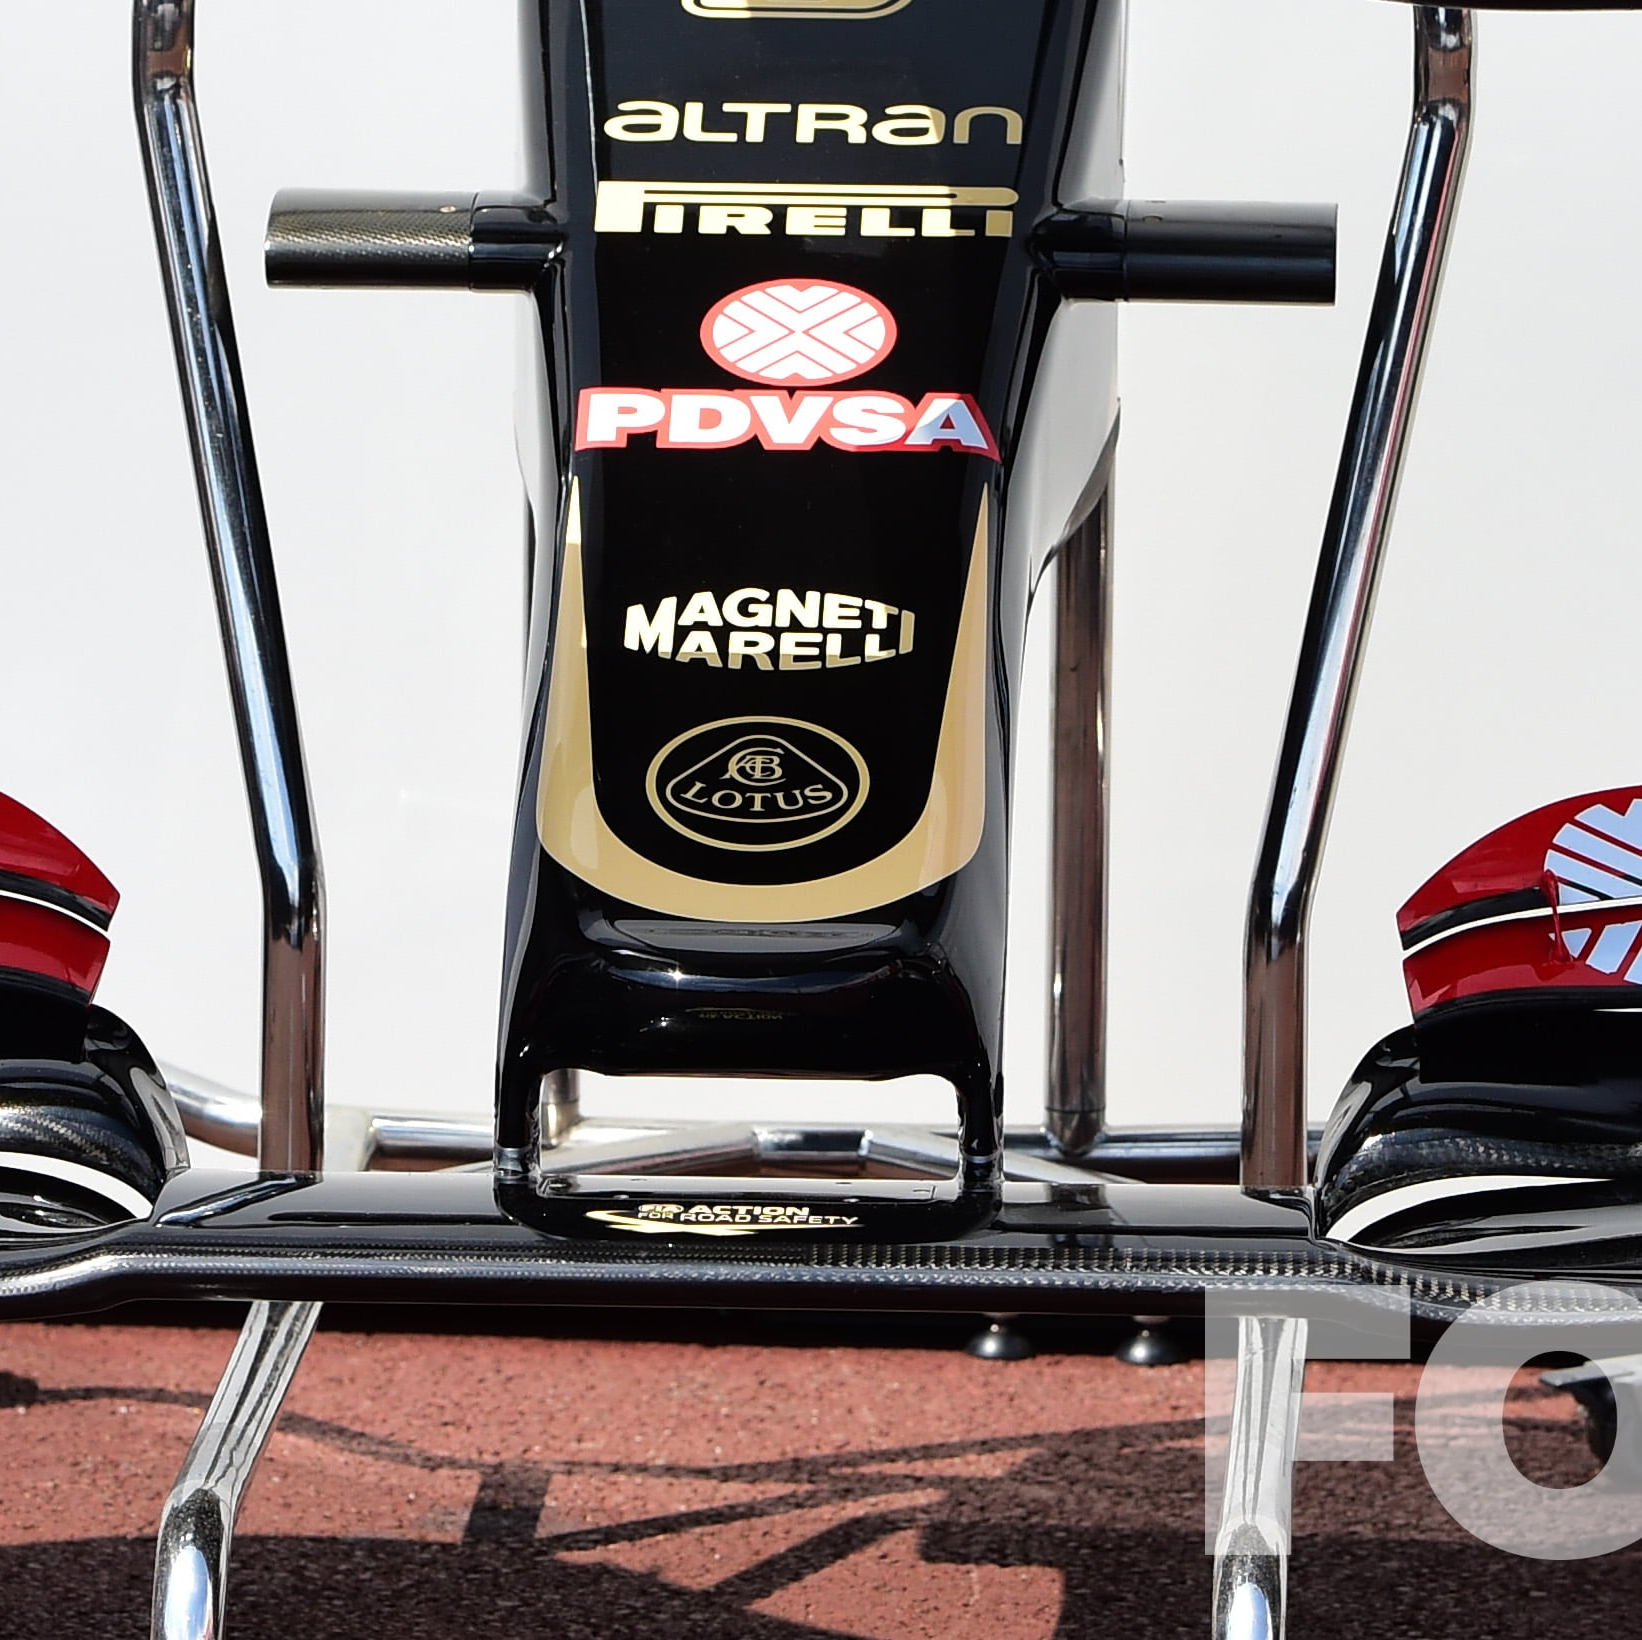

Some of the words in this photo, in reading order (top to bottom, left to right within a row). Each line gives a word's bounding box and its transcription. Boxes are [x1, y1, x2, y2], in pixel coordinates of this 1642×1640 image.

[594, 181, 1019, 237] PIRELLI
[583, 394, 989, 448] PDVSA
[624, 587, 916, 647] MAGNETI
[624, 616, 916, 671] MARELLI
[679, 780, 834, 812] LOTUS
[638, 1212, 674, 1221] FOR
[680, 1213, 752, 1223] ROAD
[758, 1215, 859, 1225] SAFETY
[689, 1205, 810, 1216] ACTION
